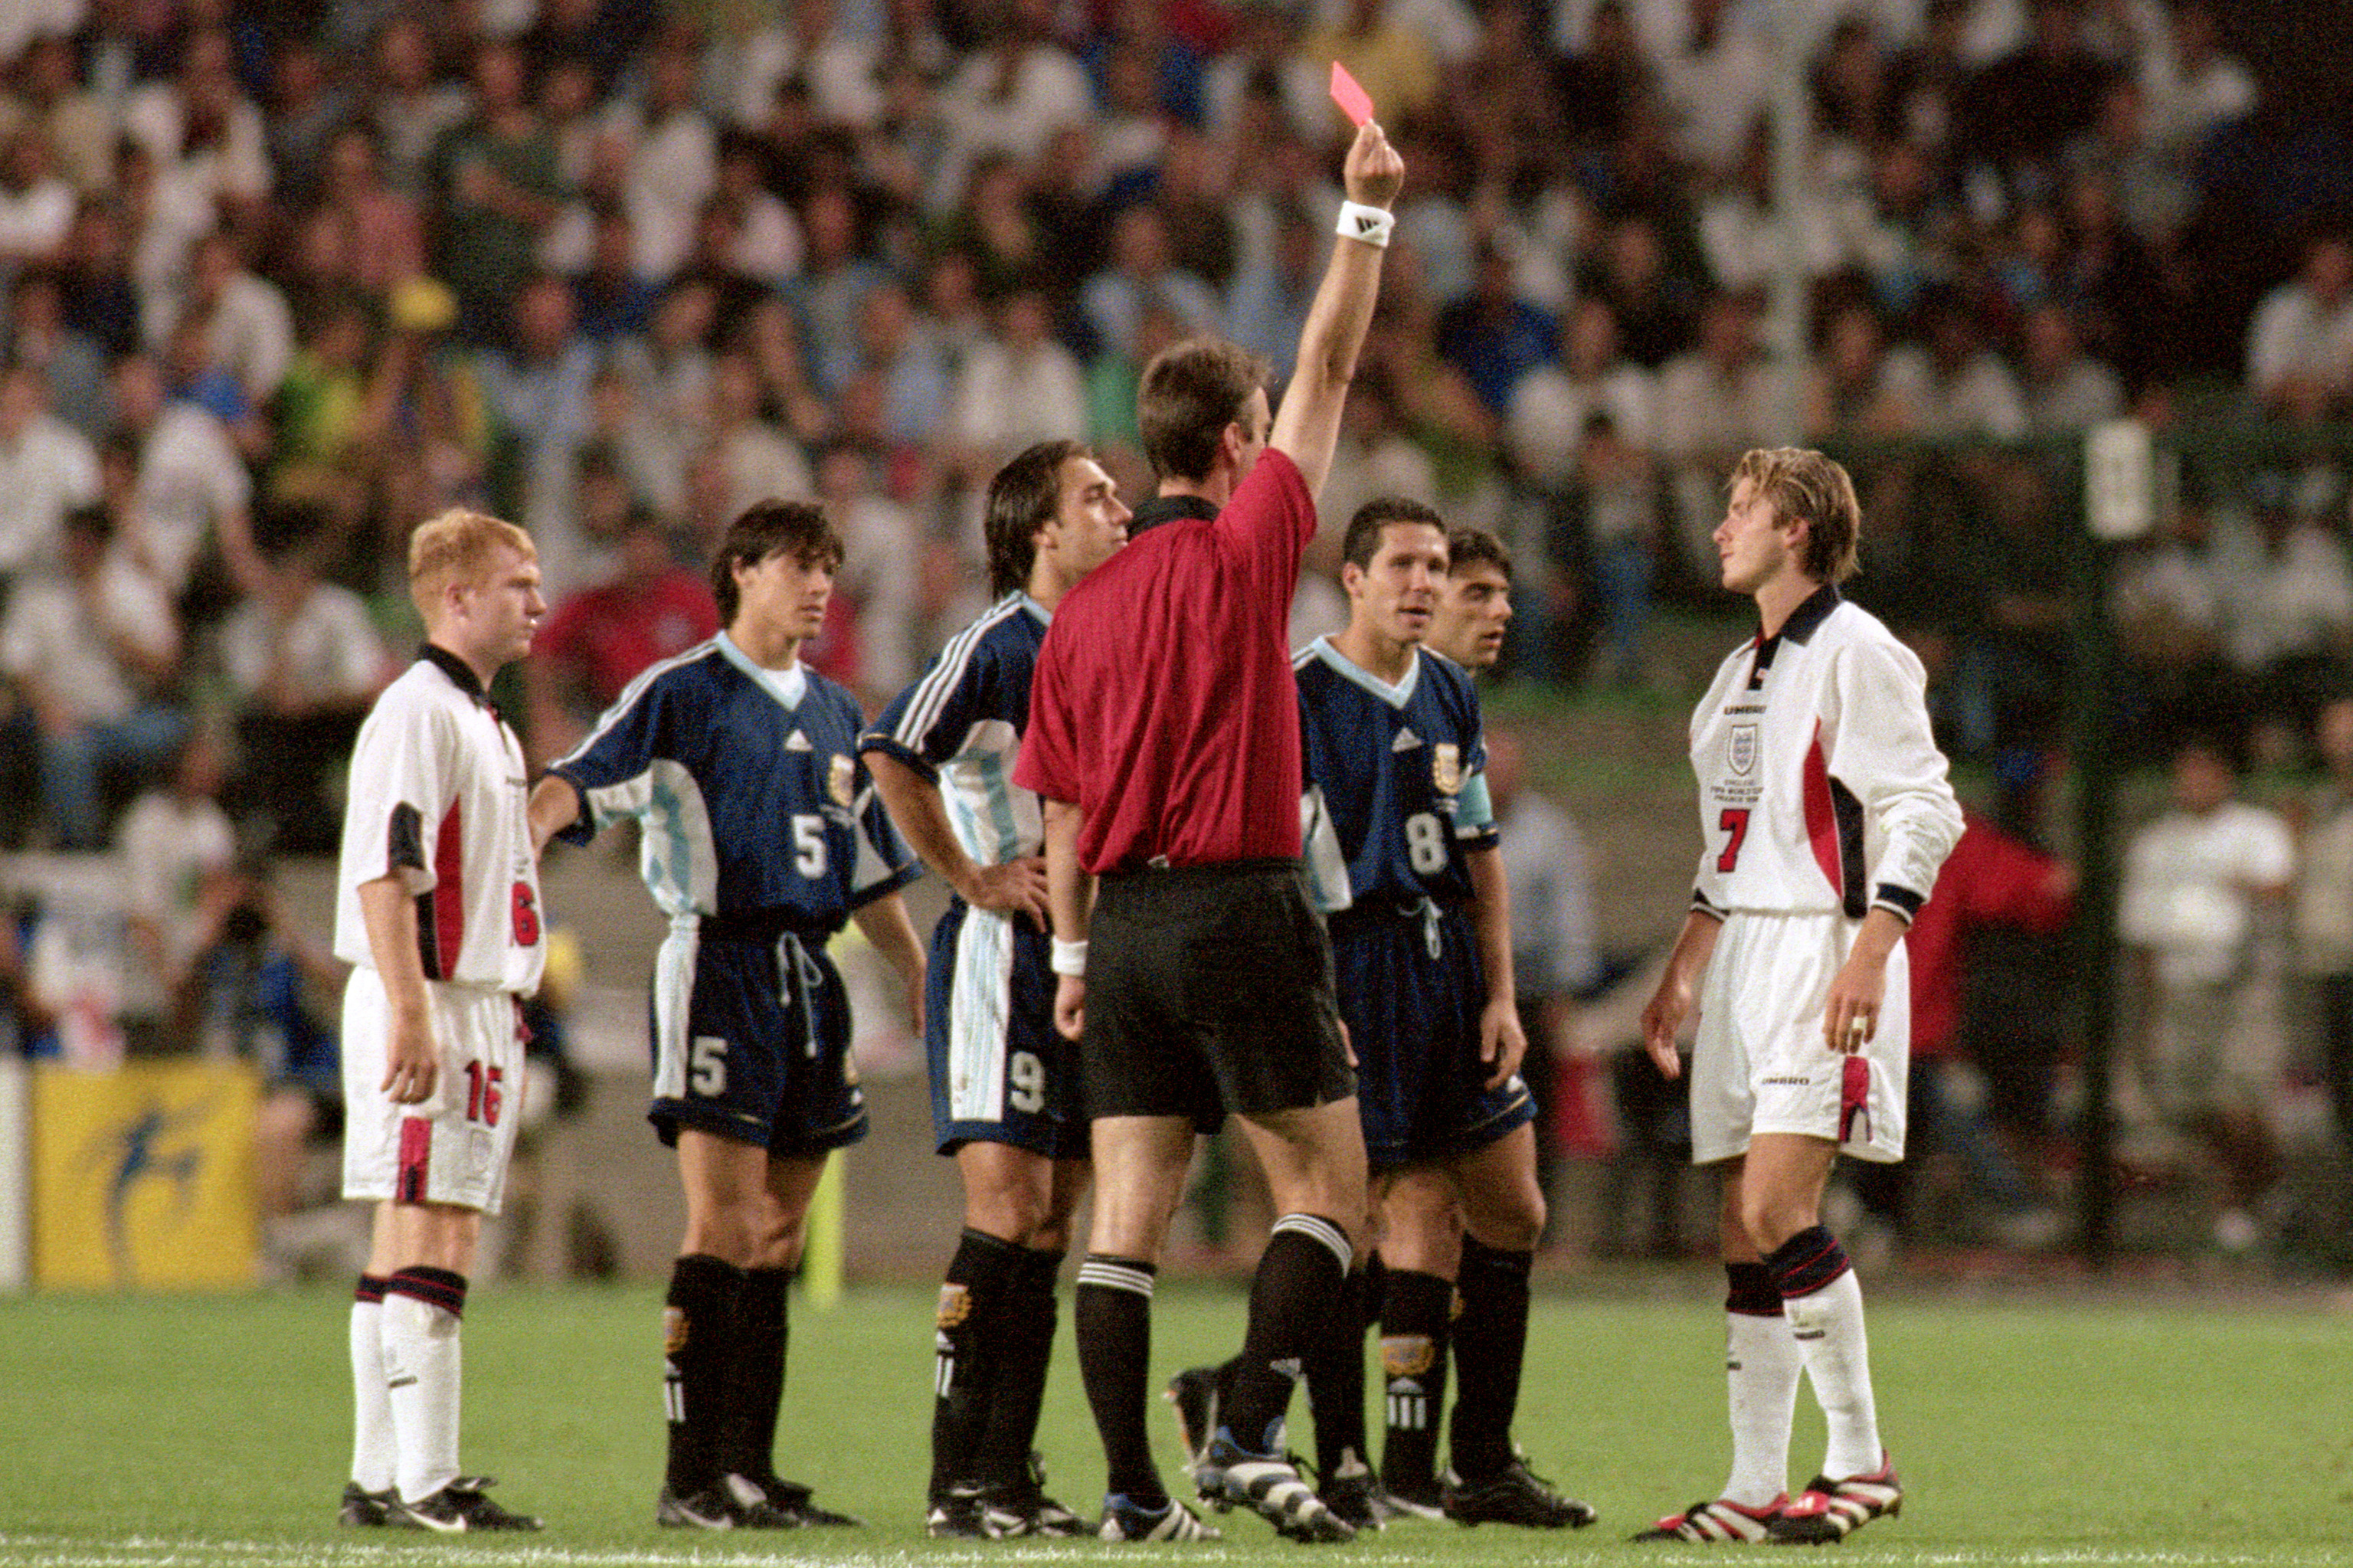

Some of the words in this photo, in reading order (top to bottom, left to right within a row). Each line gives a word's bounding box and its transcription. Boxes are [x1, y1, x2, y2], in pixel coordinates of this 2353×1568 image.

[791, 814, 827, 878] 5
[1406, 812, 1448, 874] 8
[1716, 809, 1751, 872] 7
[510, 882, 539, 948] 6
[463, 1059, 502, 1128] 16
[692, 1036, 728, 1097] 5
[1010, 1051, 1045, 1114] 9
